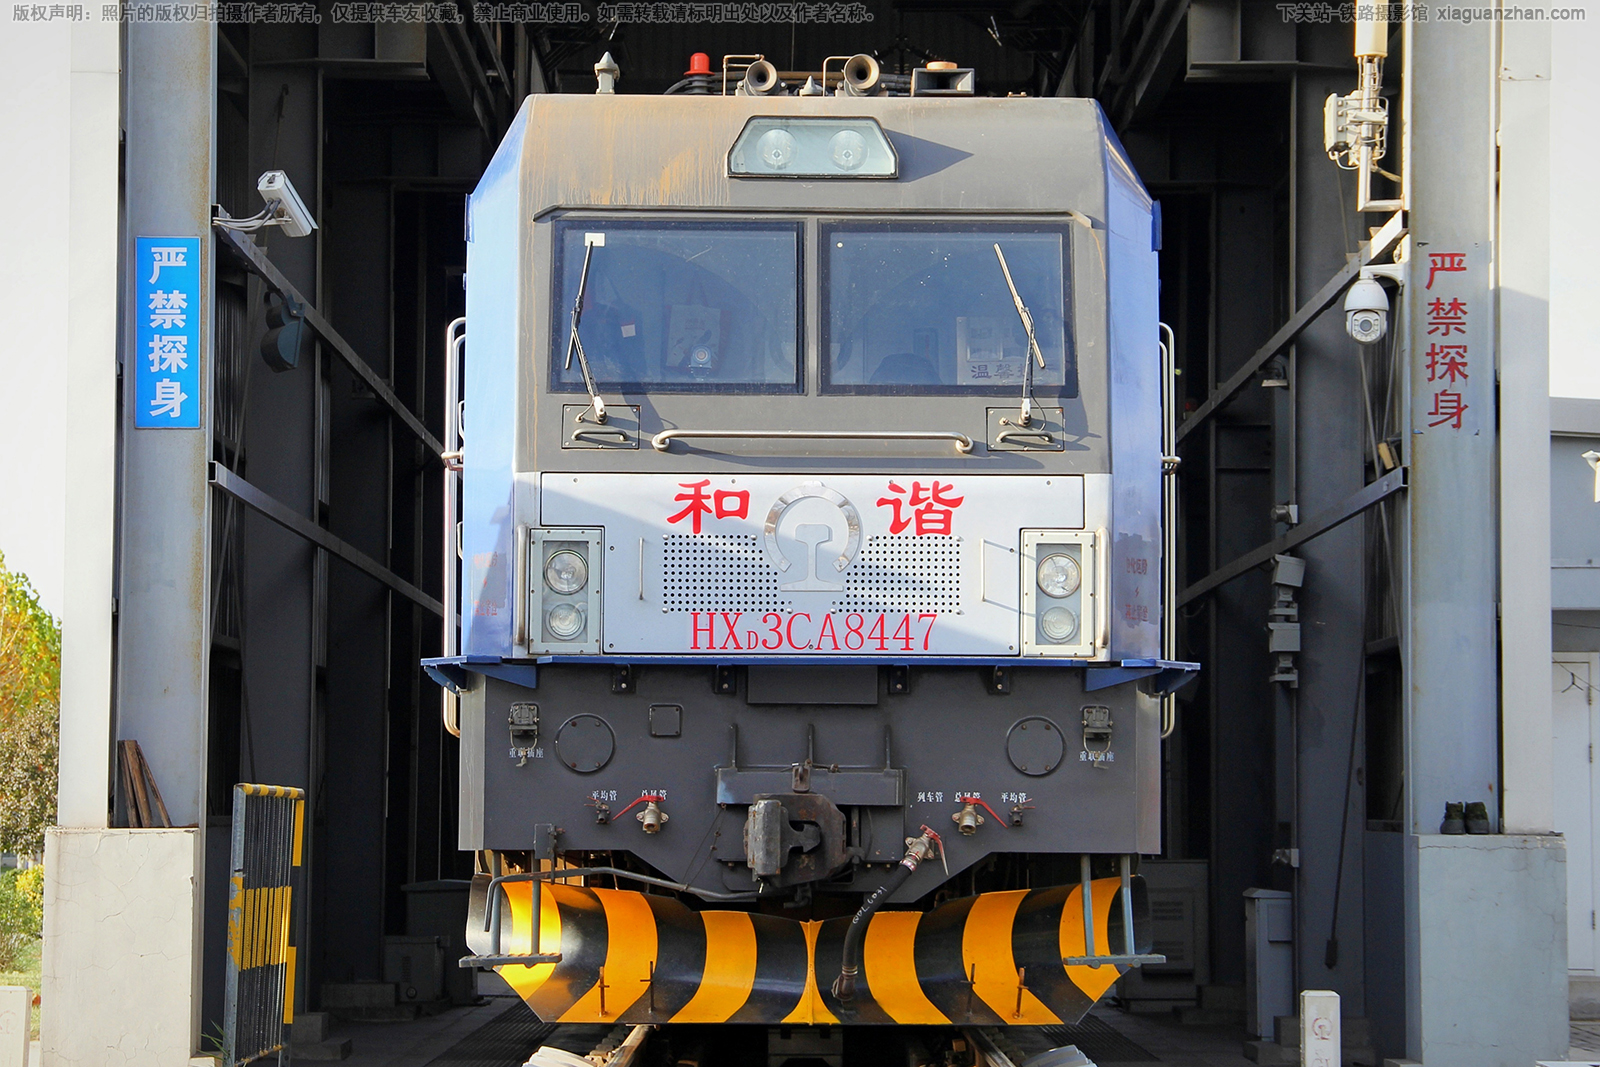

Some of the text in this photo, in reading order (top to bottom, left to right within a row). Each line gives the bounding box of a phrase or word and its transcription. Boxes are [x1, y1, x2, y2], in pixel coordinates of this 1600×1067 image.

[148, 246, 189, 418] 严禁探身
[1425, 252, 1469, 429] 严禁探身
[666, 478, 965, 536] 和 谐
[689, 611, 938, 651] HXD3CA8447
[592, 789, 618, 801] 平均管
[917, 791, 944, 803] 列车管
[1001, 791, 1028, 803] 平均管
